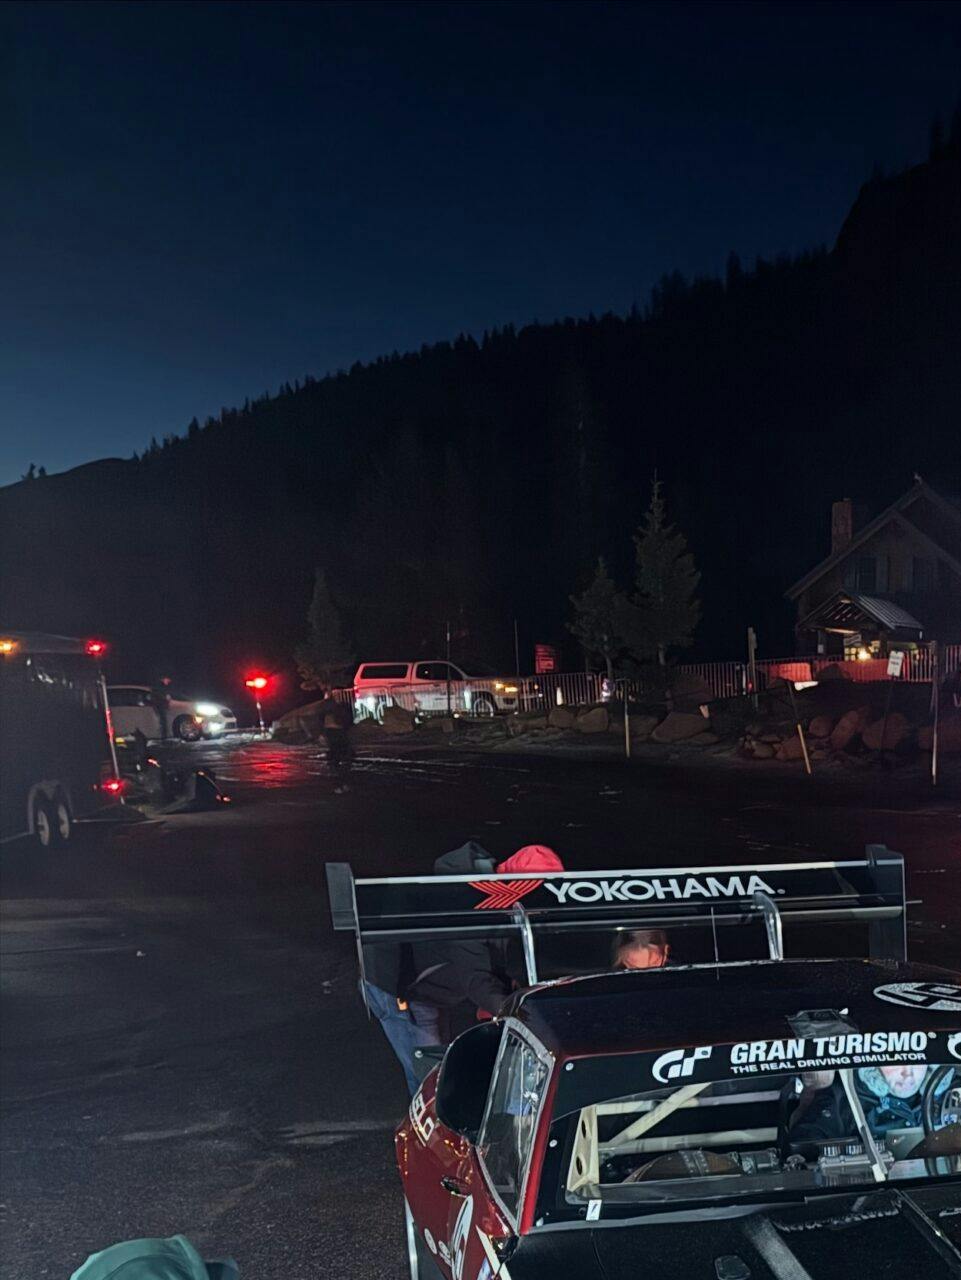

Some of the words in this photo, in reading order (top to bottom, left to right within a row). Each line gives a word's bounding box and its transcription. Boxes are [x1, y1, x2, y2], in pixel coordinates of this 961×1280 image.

[544, 874, 774, 904] YOKOHAMA
[730, 1039, 806, 1065] GRAN
[813, 1032, 928, 1056] TURISMO
[731, 1065, 758, 1074] THE
[761, 1061, 796, 1072] REAL
[797, 1056, 850, 1068] DRIVING
[852, 1052, 927, 1064] SIMULATOR
